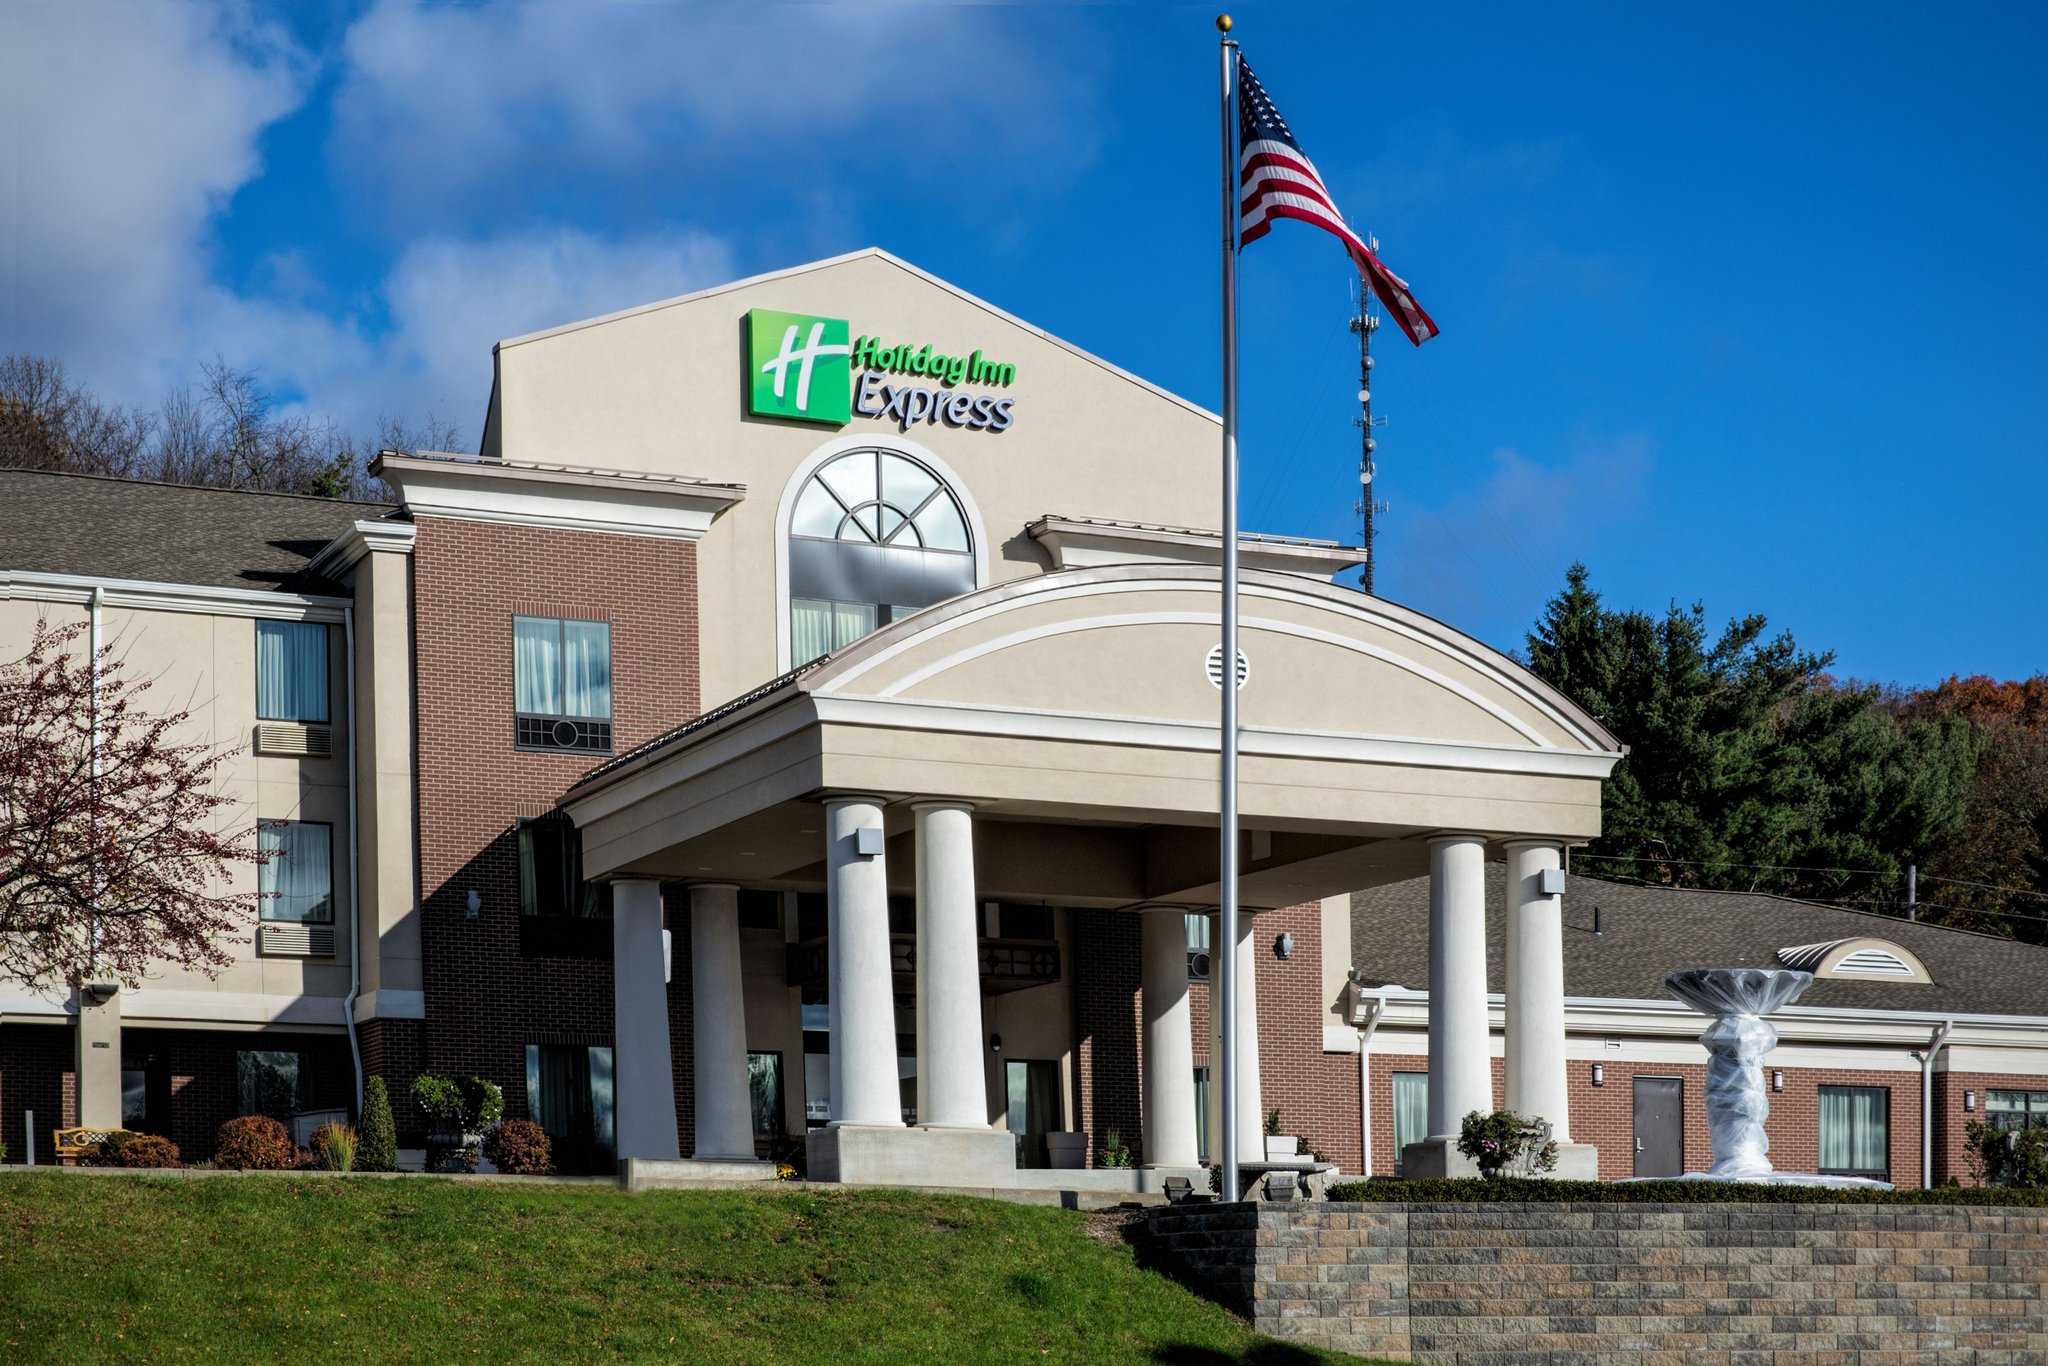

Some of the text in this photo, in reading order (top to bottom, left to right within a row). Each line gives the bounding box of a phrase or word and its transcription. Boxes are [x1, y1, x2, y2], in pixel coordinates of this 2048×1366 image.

[853, 335, 1016, 386] Holiday Inn
[855, 371, 1016, 431] Express
